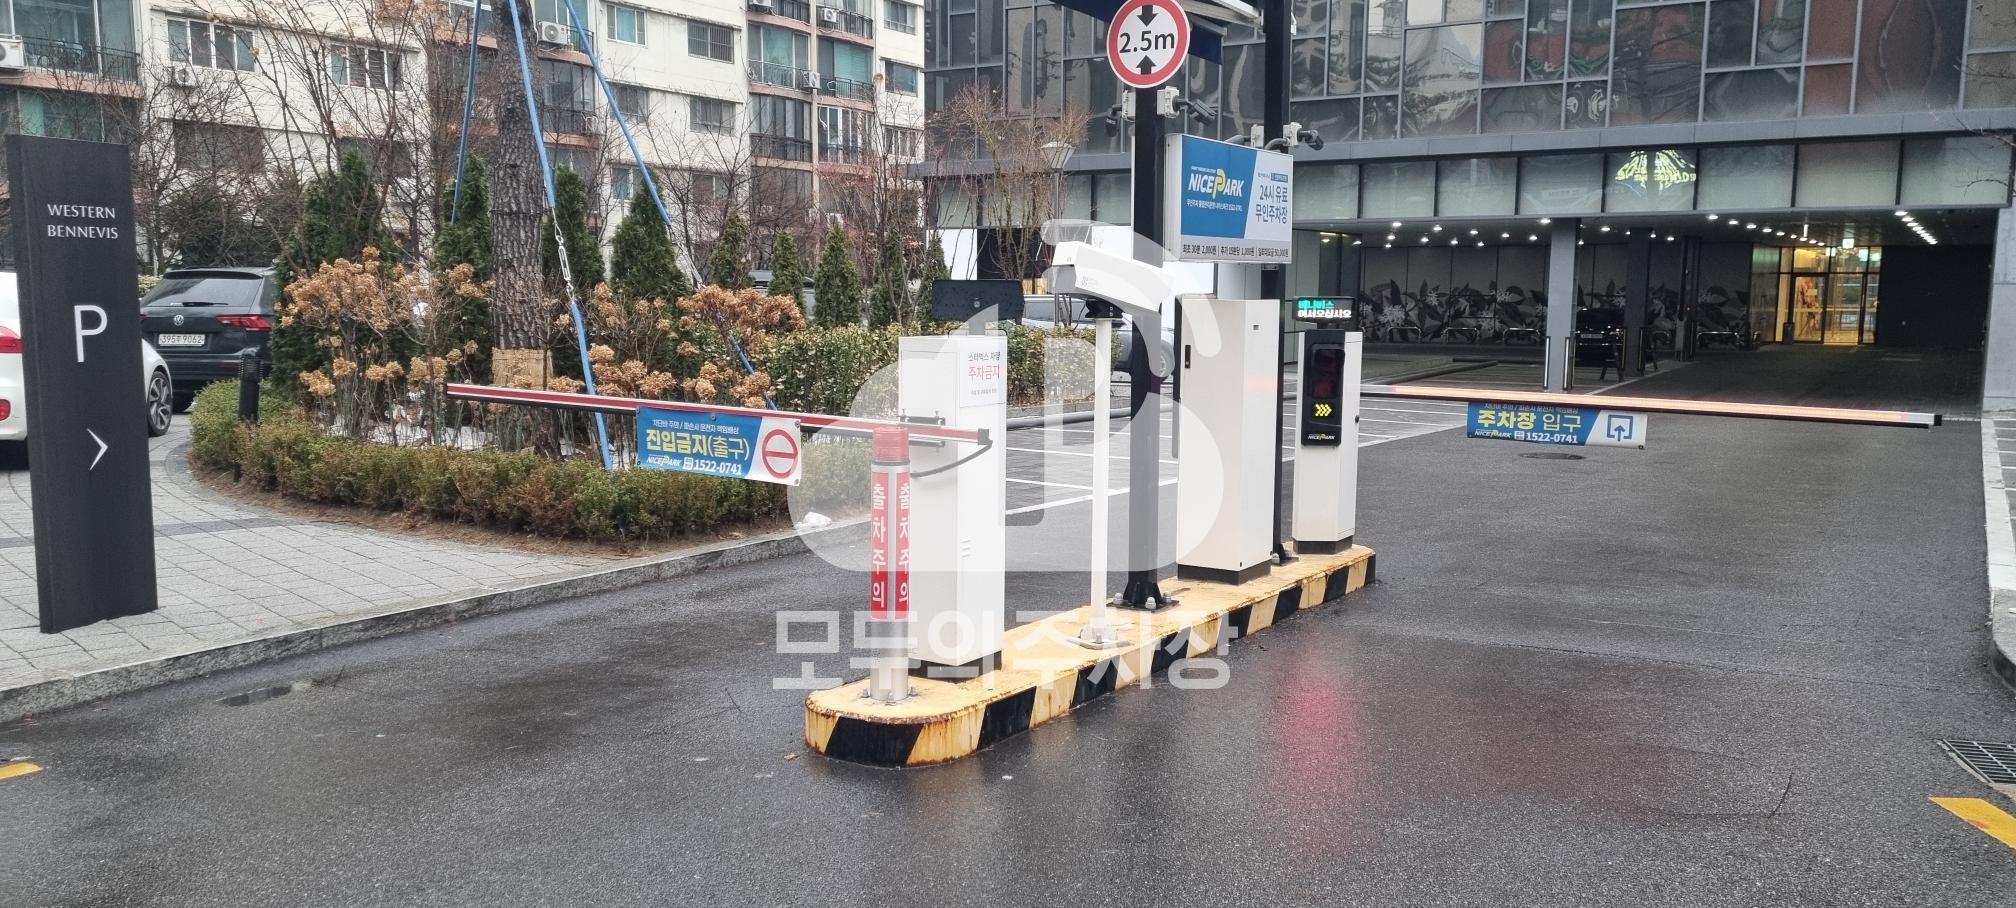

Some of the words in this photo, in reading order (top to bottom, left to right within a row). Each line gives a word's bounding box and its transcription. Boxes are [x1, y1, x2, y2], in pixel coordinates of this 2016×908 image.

[1119, 30, 1175, 54] 2.5m
[1260, 185, 1274, 201] 24시
[47, 203, 116, 219] WESTERN
[1255, 204, 1288, 224] 무인주차장
[47, 225, 119, 240] BENNEVIS
[1298, 309, 1352, 318] 어서오십시오
[74, 304, 108, 363] P
[183, 335, 202, 344] 9062
[968, 364, 1000, 382] 주차금지
[1477, 409, 1537, 430] 주차장
[1542, 413, 1582, 433] 입구
[646, 429, 750, 461] 진입금지(출구)
[1526, 432, 1578, 444] 1522-0741
[694, 459, 742, 475] 1522-0741
